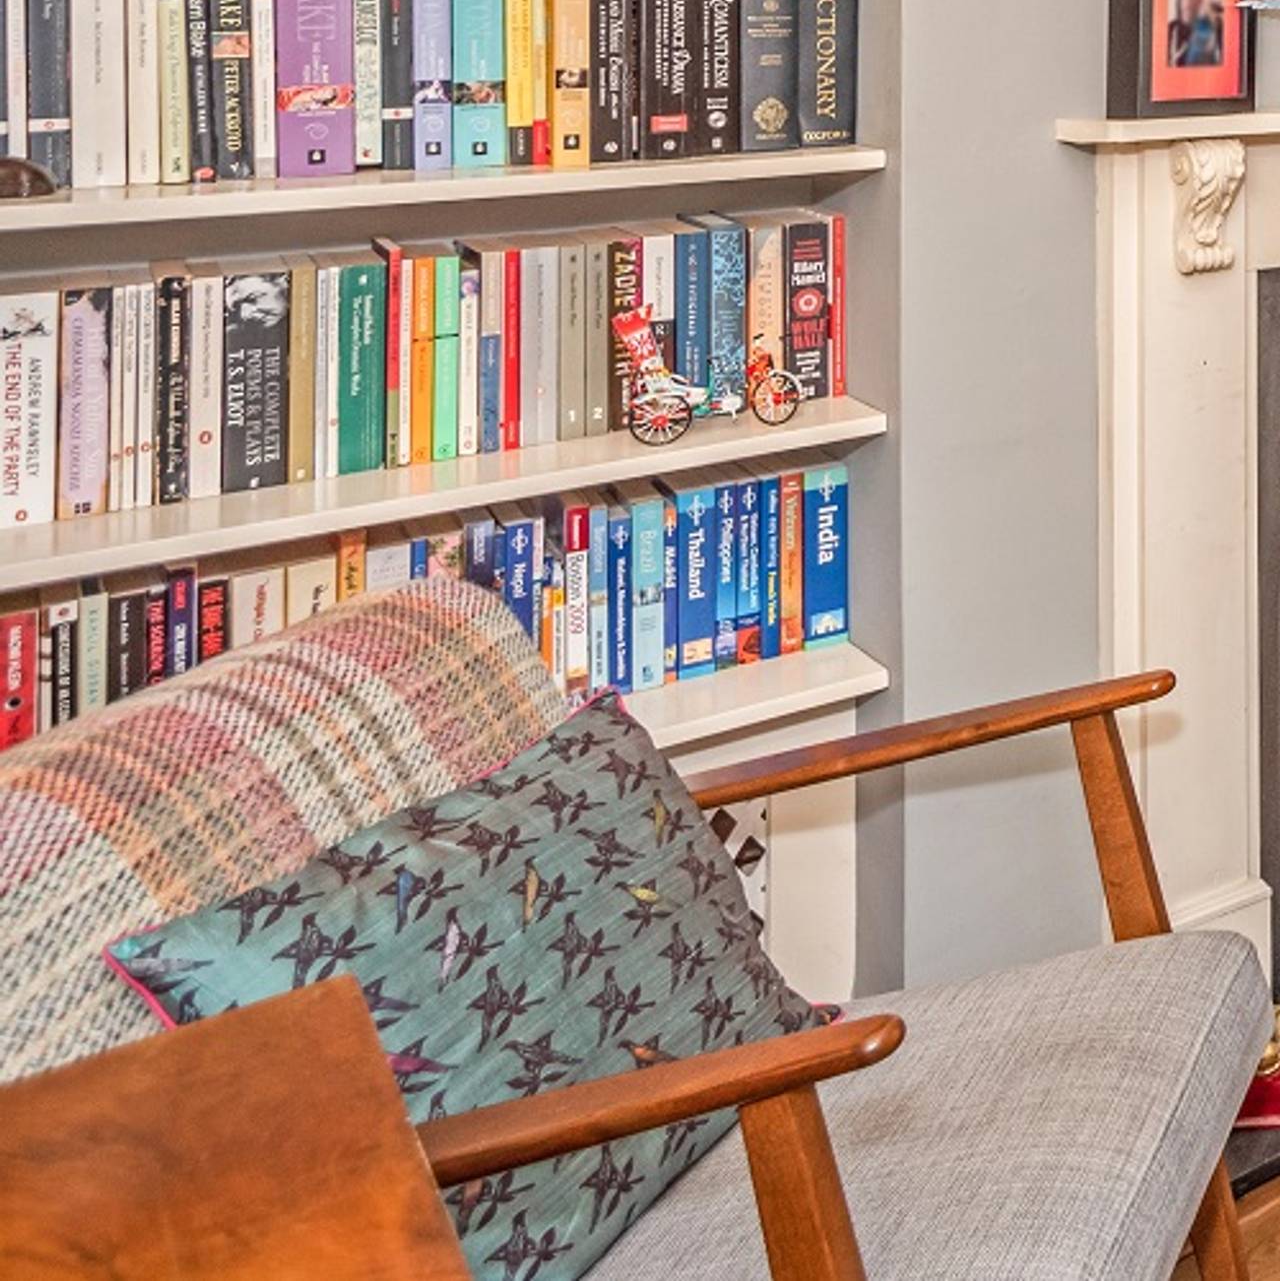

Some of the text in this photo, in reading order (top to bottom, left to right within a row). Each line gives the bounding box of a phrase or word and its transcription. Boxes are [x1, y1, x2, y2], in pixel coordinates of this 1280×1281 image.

[189, 19, 207, 58] Blake
[609, 18, 624, 54] MIDDLE
[223, 60, 241, 95] PETER
[609, 55, 624, 92] ENGLISH
[671, 48, 693, 95] DRAMA
[224, 95, 242, 152] ACKROYD
[613, 250, 636, 307] ZADIE
[790, 273, 826, 287] Mantel
[791, 319, 826, 334] WOLF
[792, 333, 827, 350] HALL
[68, 316, 84, 493] CHIMAMANDA NGOZI ADICHIE
[227, 348, 244, 428] T. S. ELIOT
[246, 348, 261, 467] POEMS & PLAYS
[264, 346, 281, 463] THE COMPLETE
[3, 342, 23, 496] THE END OF THE PARTY
[25, 356, 43, 478] ANDREW RAWNSLEY
[640, 529, 656, 574] Brazil
[717, 517, 734, 583] Philippines
[817, 504, 839, 566] India
[511, 562, 528, 599] Nepal
[665, 546, 676, 589] Madrid
[689, 528, 706, 600] Thailand
[570, 554, 585, 635] Boston 2009
[86, 607, 99, 705] KAHLIL GIBRAN
